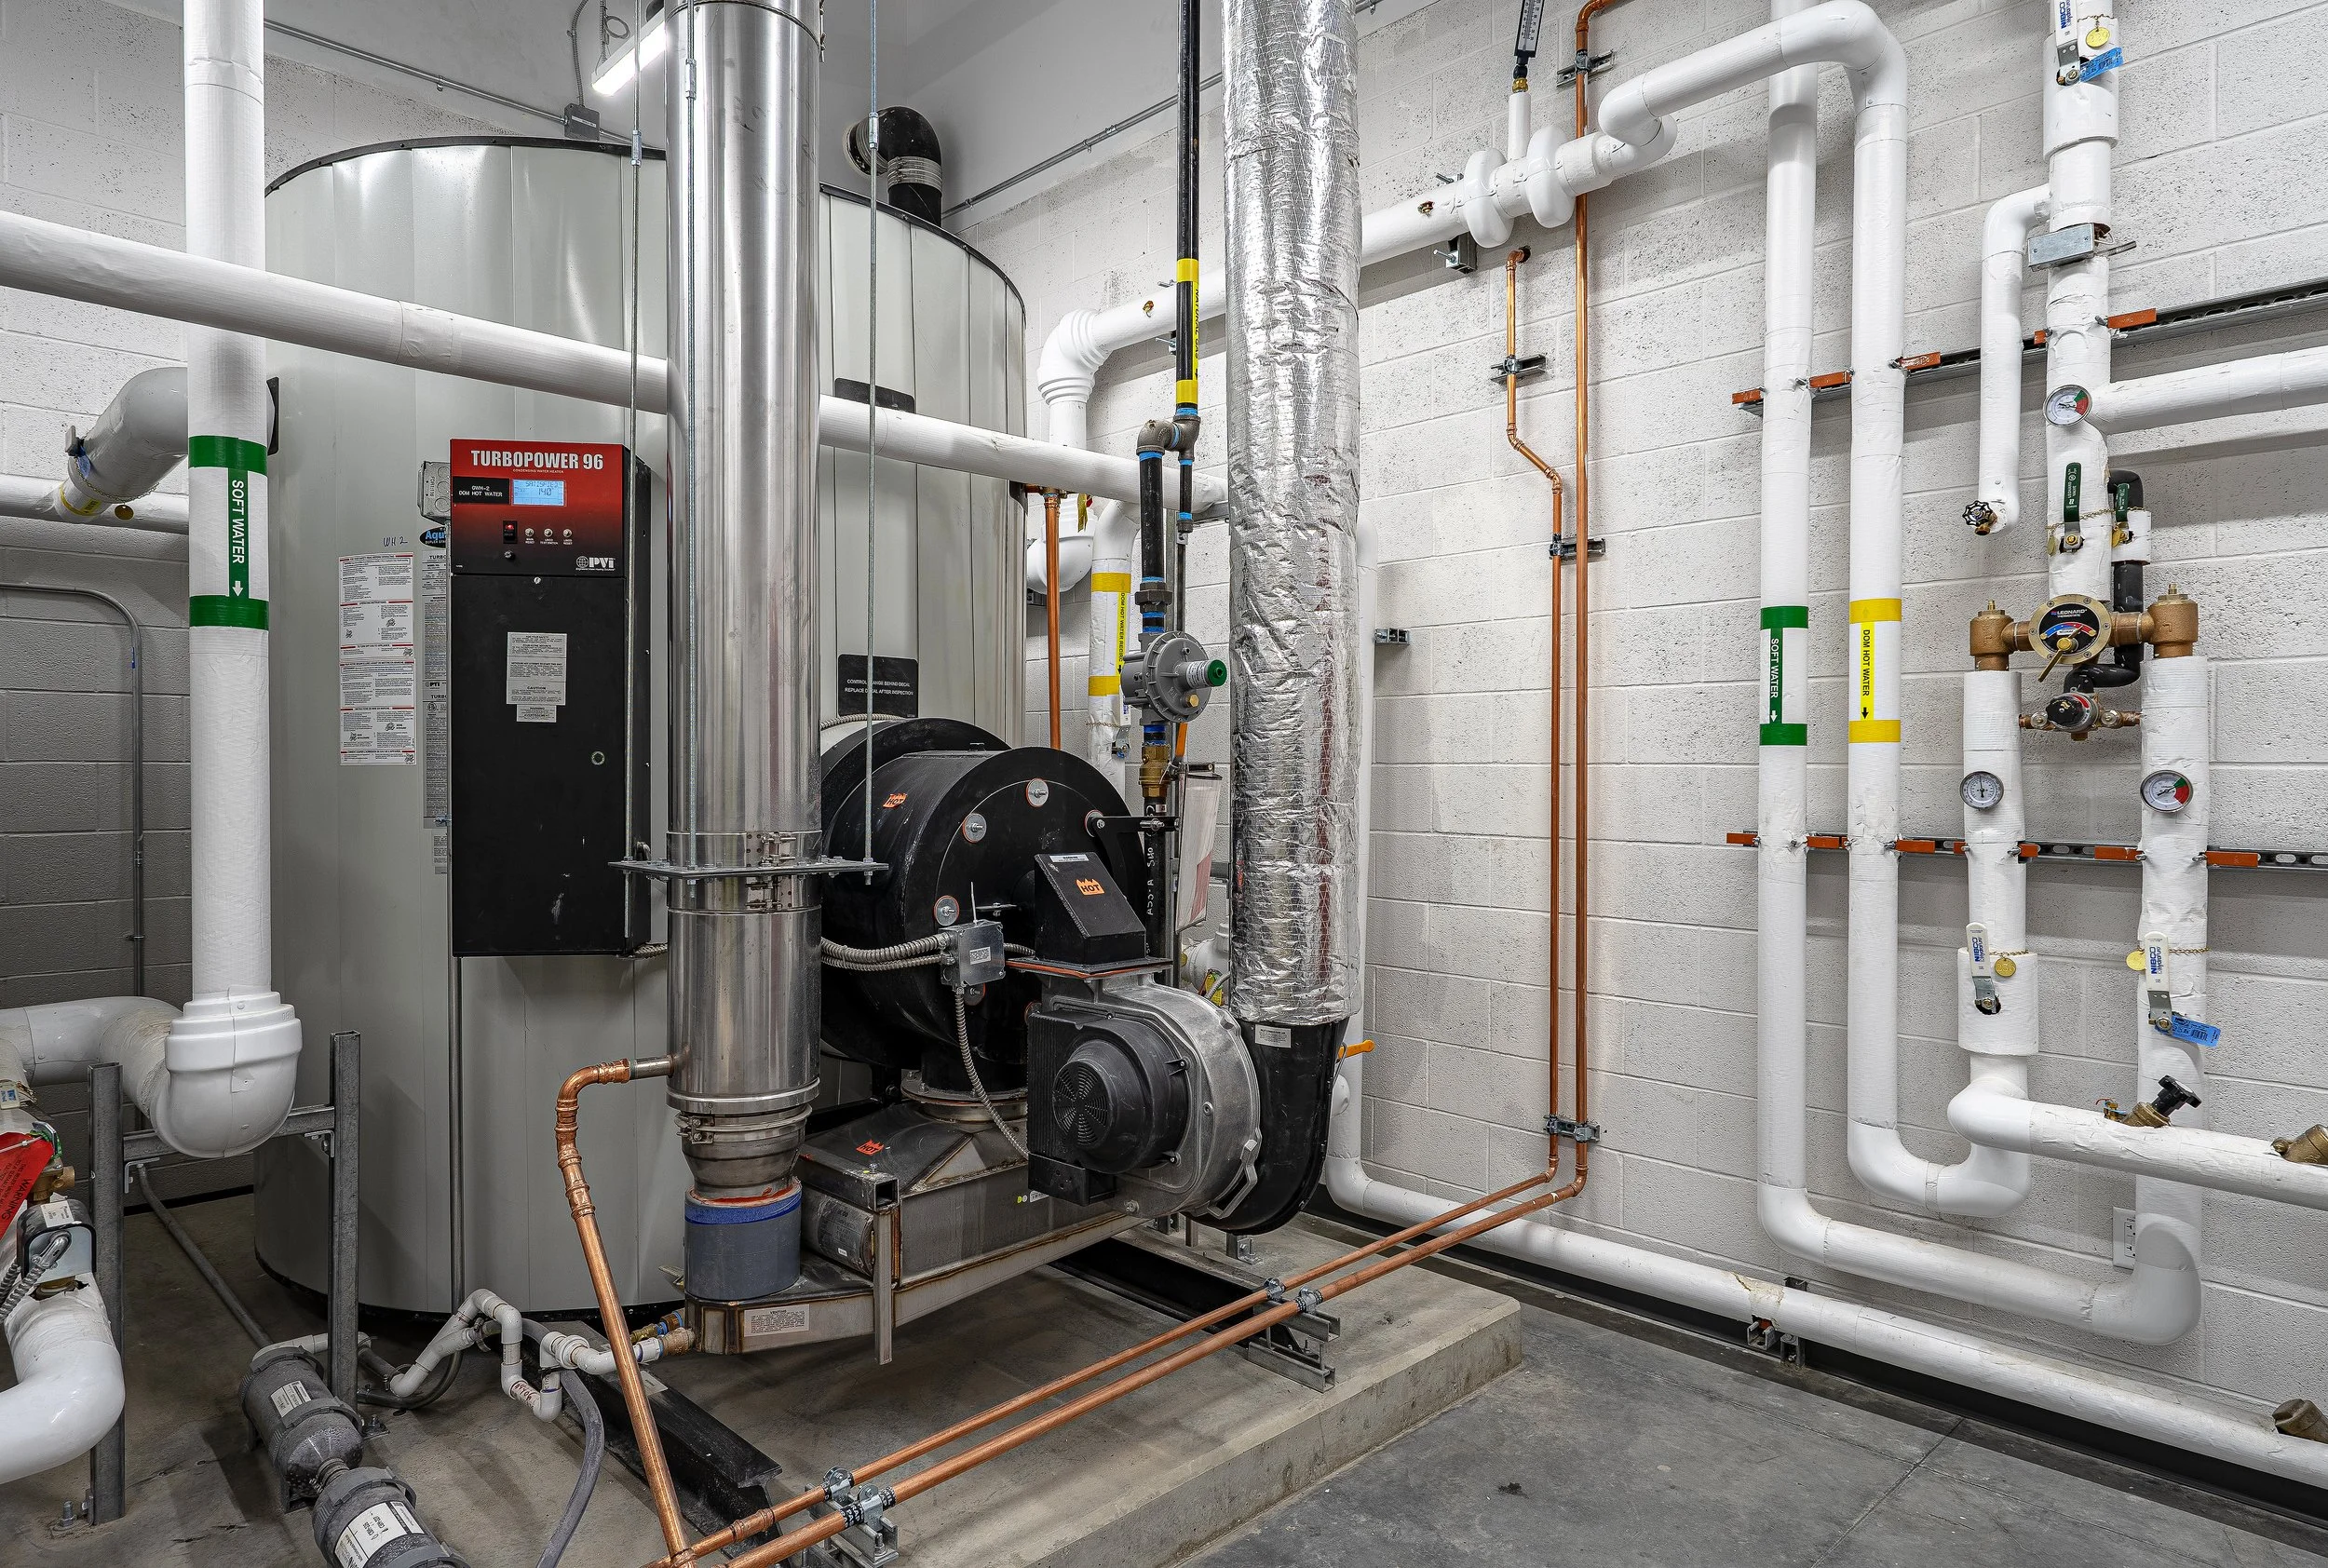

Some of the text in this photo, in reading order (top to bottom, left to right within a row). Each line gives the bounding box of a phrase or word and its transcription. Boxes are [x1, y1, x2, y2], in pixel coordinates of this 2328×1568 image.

[471, 450, 603, 470] TURBOPOWER 96
[231, 480, 245, 564] SOFT WATER
[399, 536, 408, 544] 2
[1972, 937, 1980, 962] NIBCO
[2, 1178, 33, 1221] WARNING
